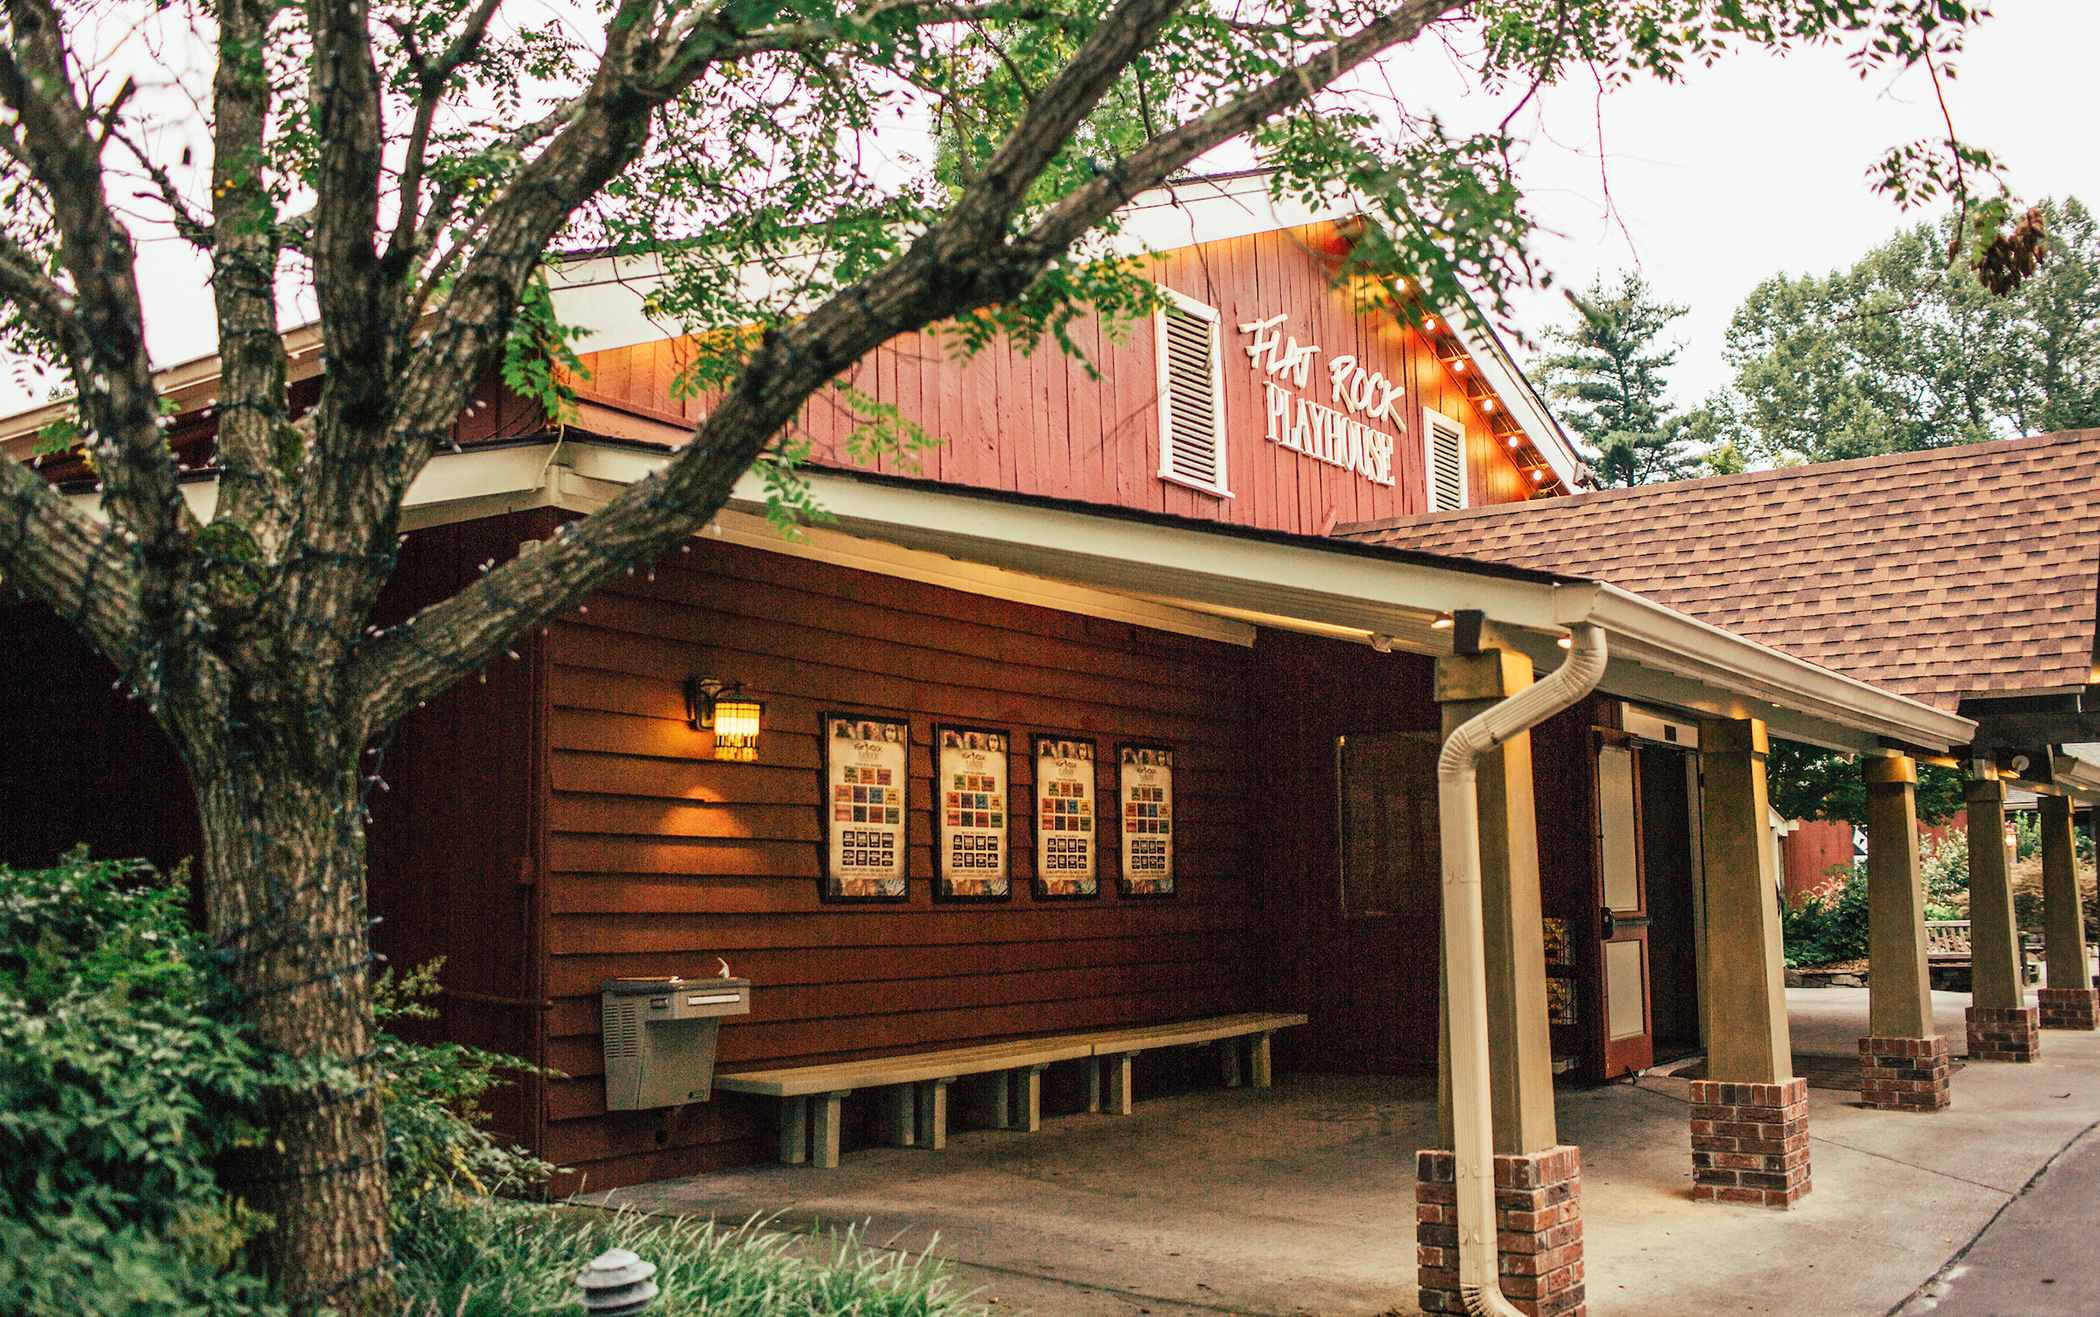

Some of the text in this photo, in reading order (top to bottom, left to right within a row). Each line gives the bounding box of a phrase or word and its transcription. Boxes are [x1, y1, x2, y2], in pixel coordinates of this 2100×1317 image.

[1239, 313, 1407, 433] FLAT ROCK
[1263, 380, 1395, 486] PLAYHOUSE
